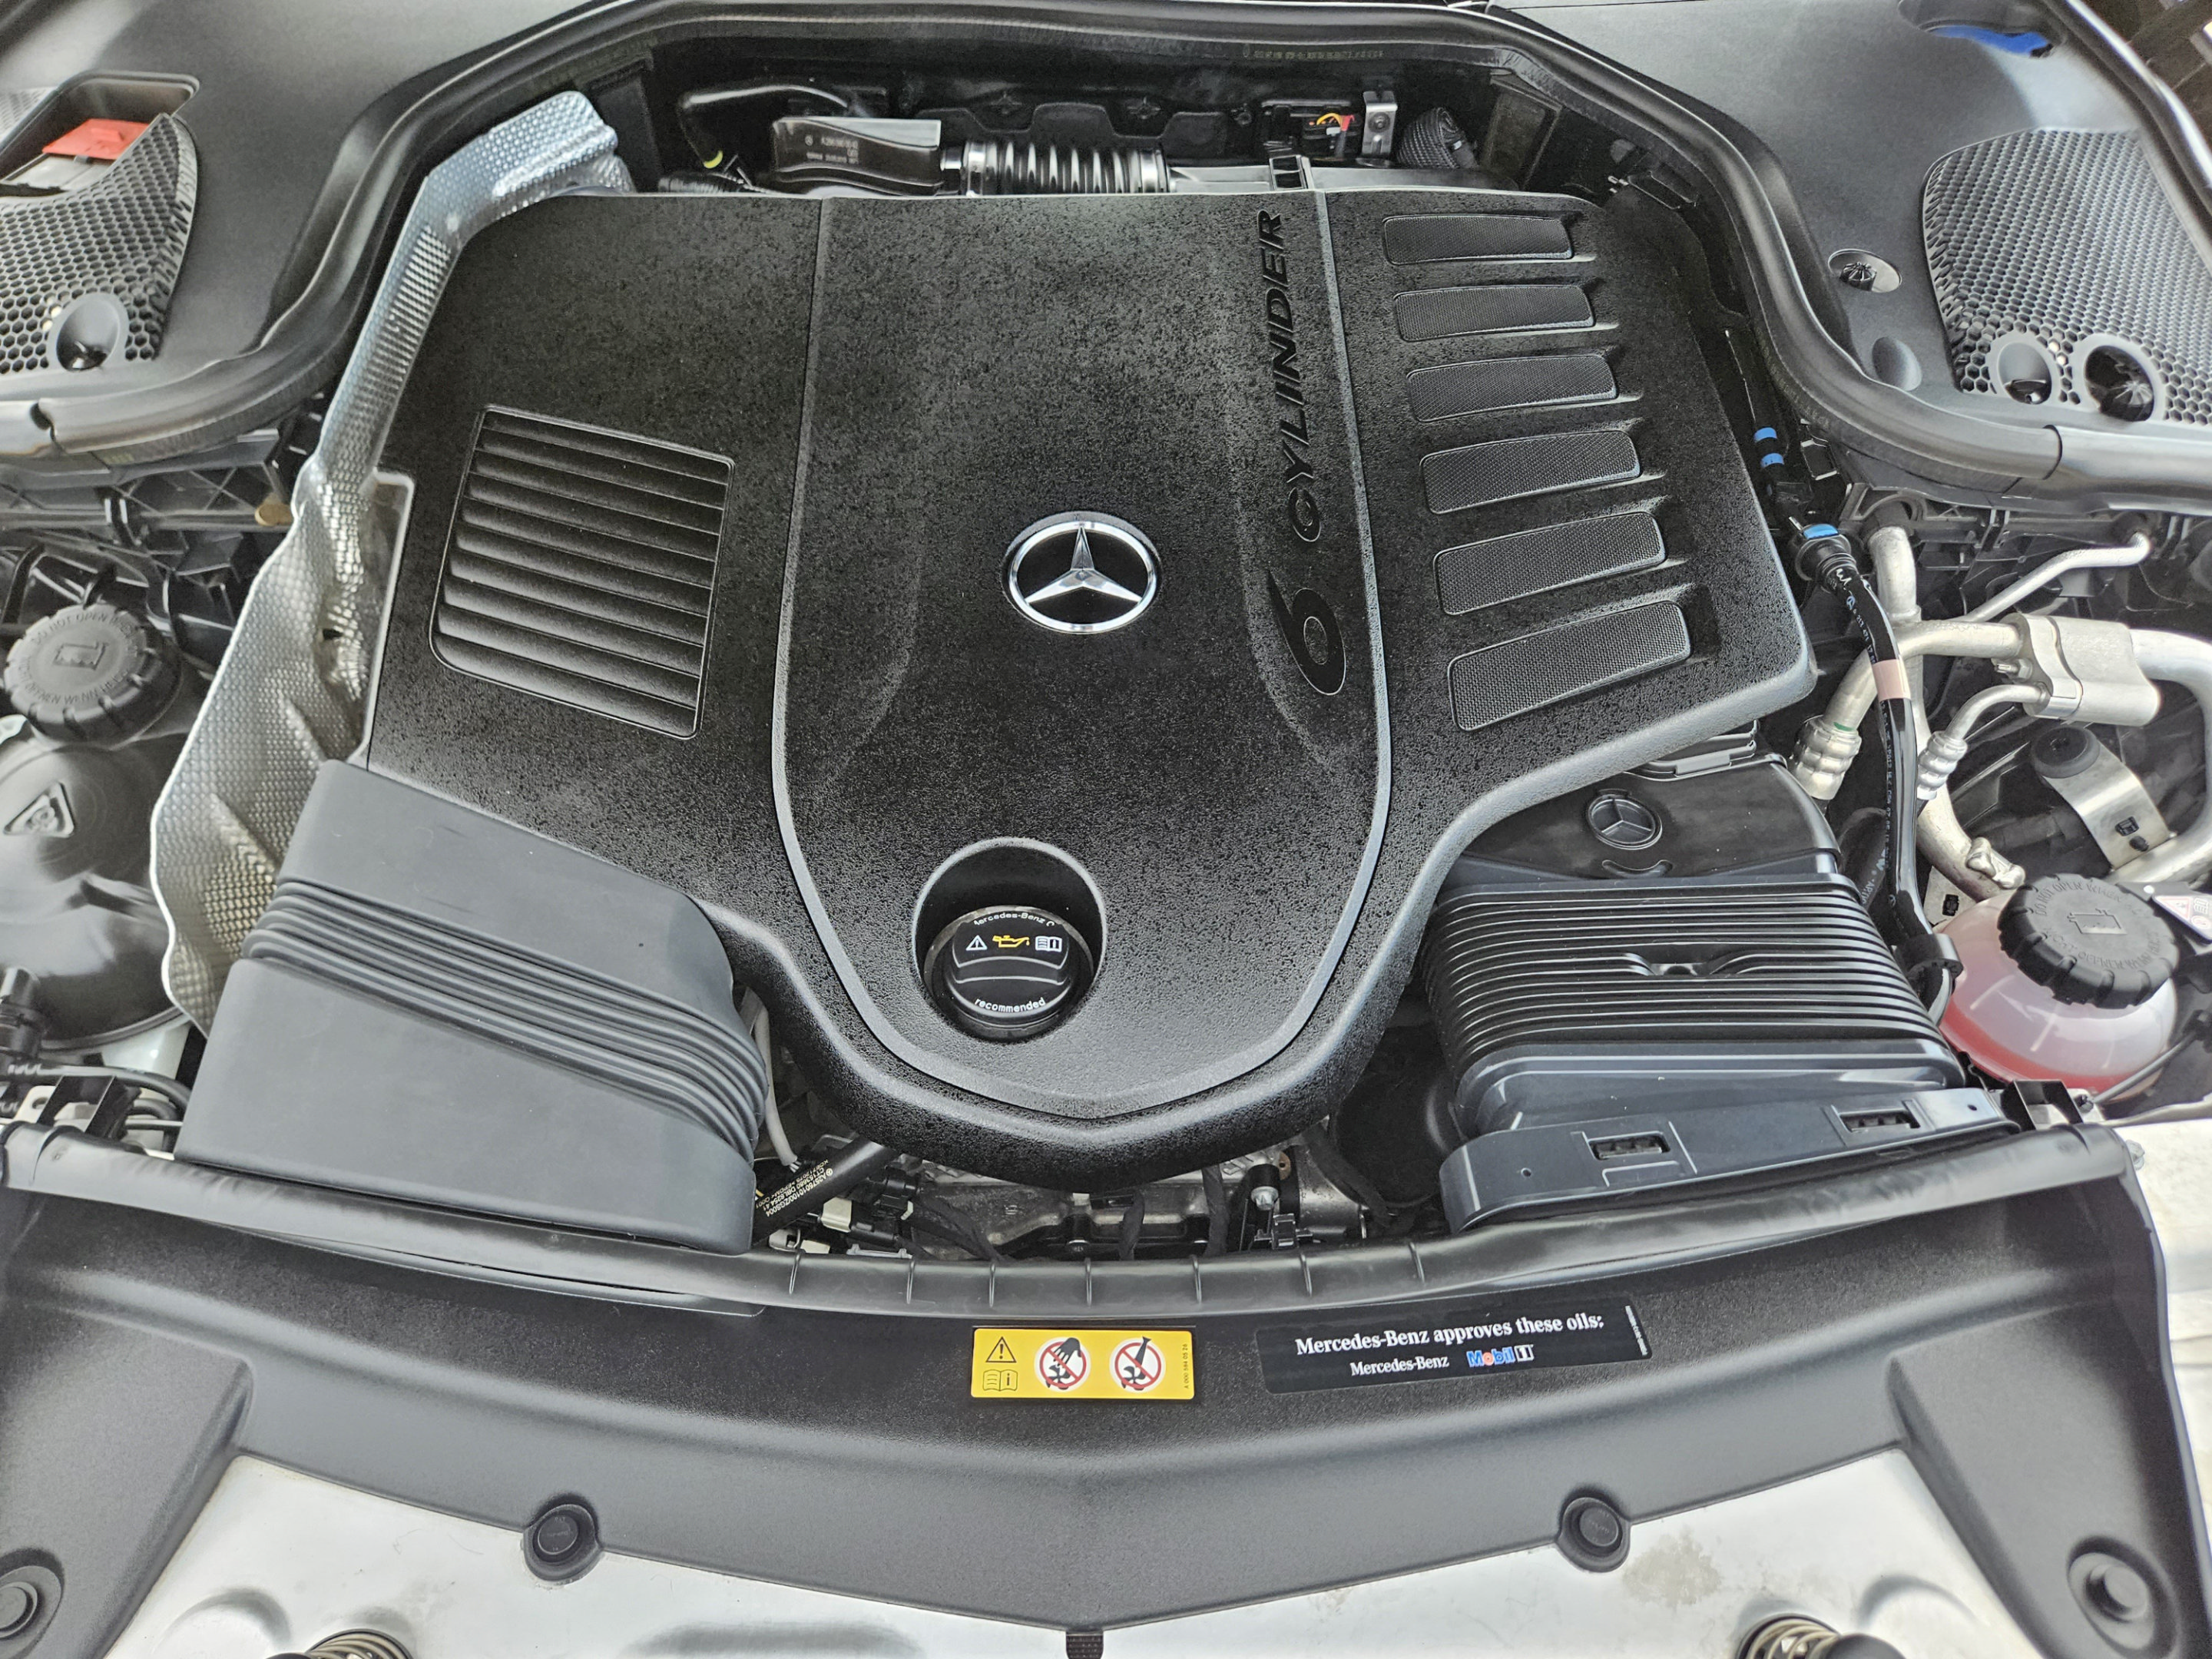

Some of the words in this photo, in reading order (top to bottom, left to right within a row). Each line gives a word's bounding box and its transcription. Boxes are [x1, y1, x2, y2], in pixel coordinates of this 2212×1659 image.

[1257, 209, 1321, 542] CYLINDER
[1266, 569, 1346, 696] 6
[2052, 882, 2083, 892] OPEN
[975, 997, 1045, 1012] recommended
[1295, 1330, 1429, 1355] Mercedes-Benz
[1433, 1322, 1512, 1346] approves
[1515, 1316, 1563, 1334] these
[1567, 1312, 1604, 1330] oils:
[1349, 1356, 1450, 1376] Mercedes-Benz
[1466, 1346, 1516, 1367] Mobil
